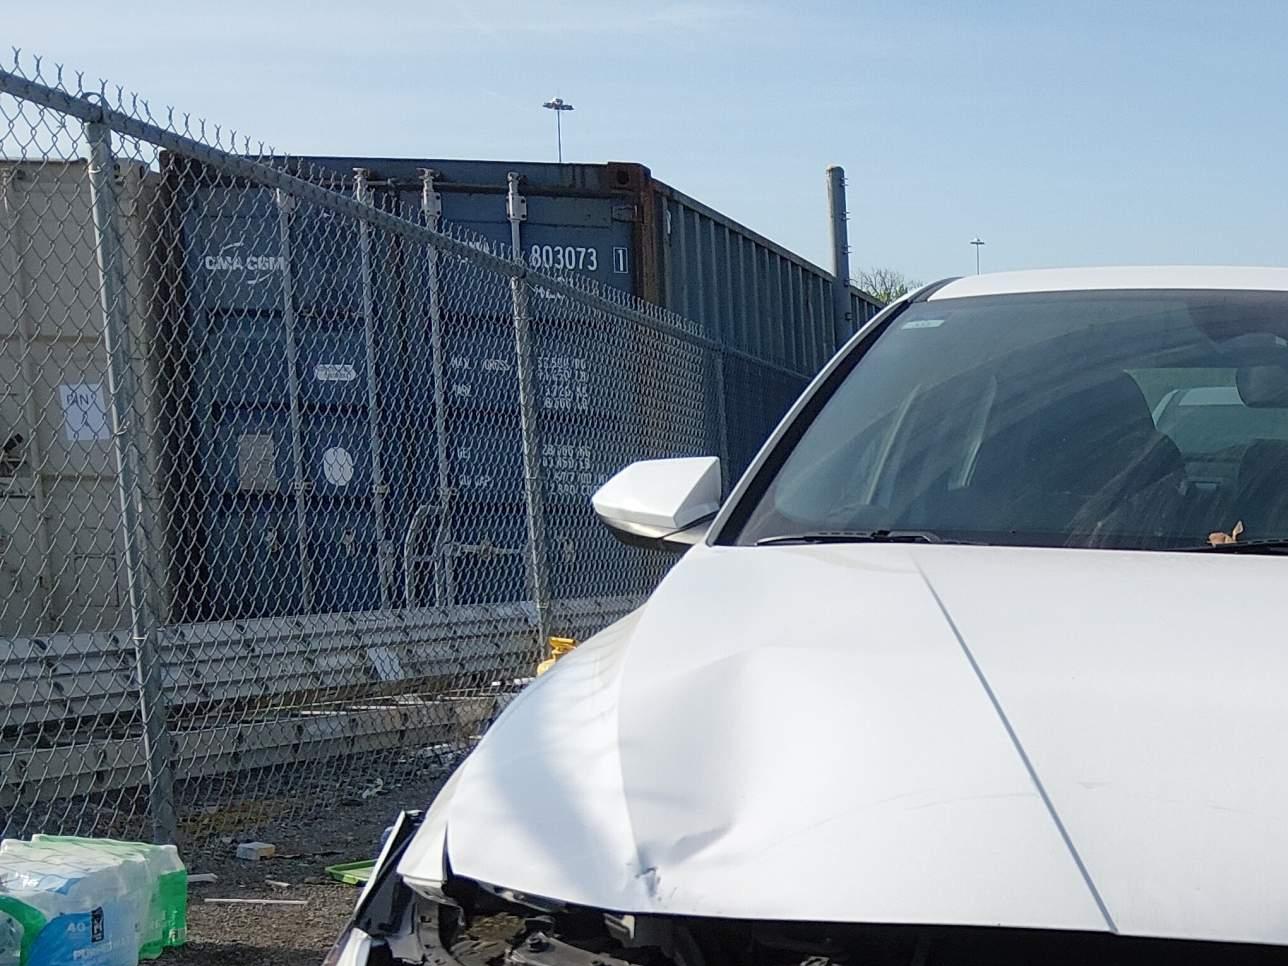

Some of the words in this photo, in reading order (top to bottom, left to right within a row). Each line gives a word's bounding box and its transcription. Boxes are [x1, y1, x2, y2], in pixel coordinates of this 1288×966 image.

[205, 255, 243, 271] CMA
[247, 255, 284, 271] CGM
[531, 245, 597, 271] 803073
[66, 921, 86, 933] 40
